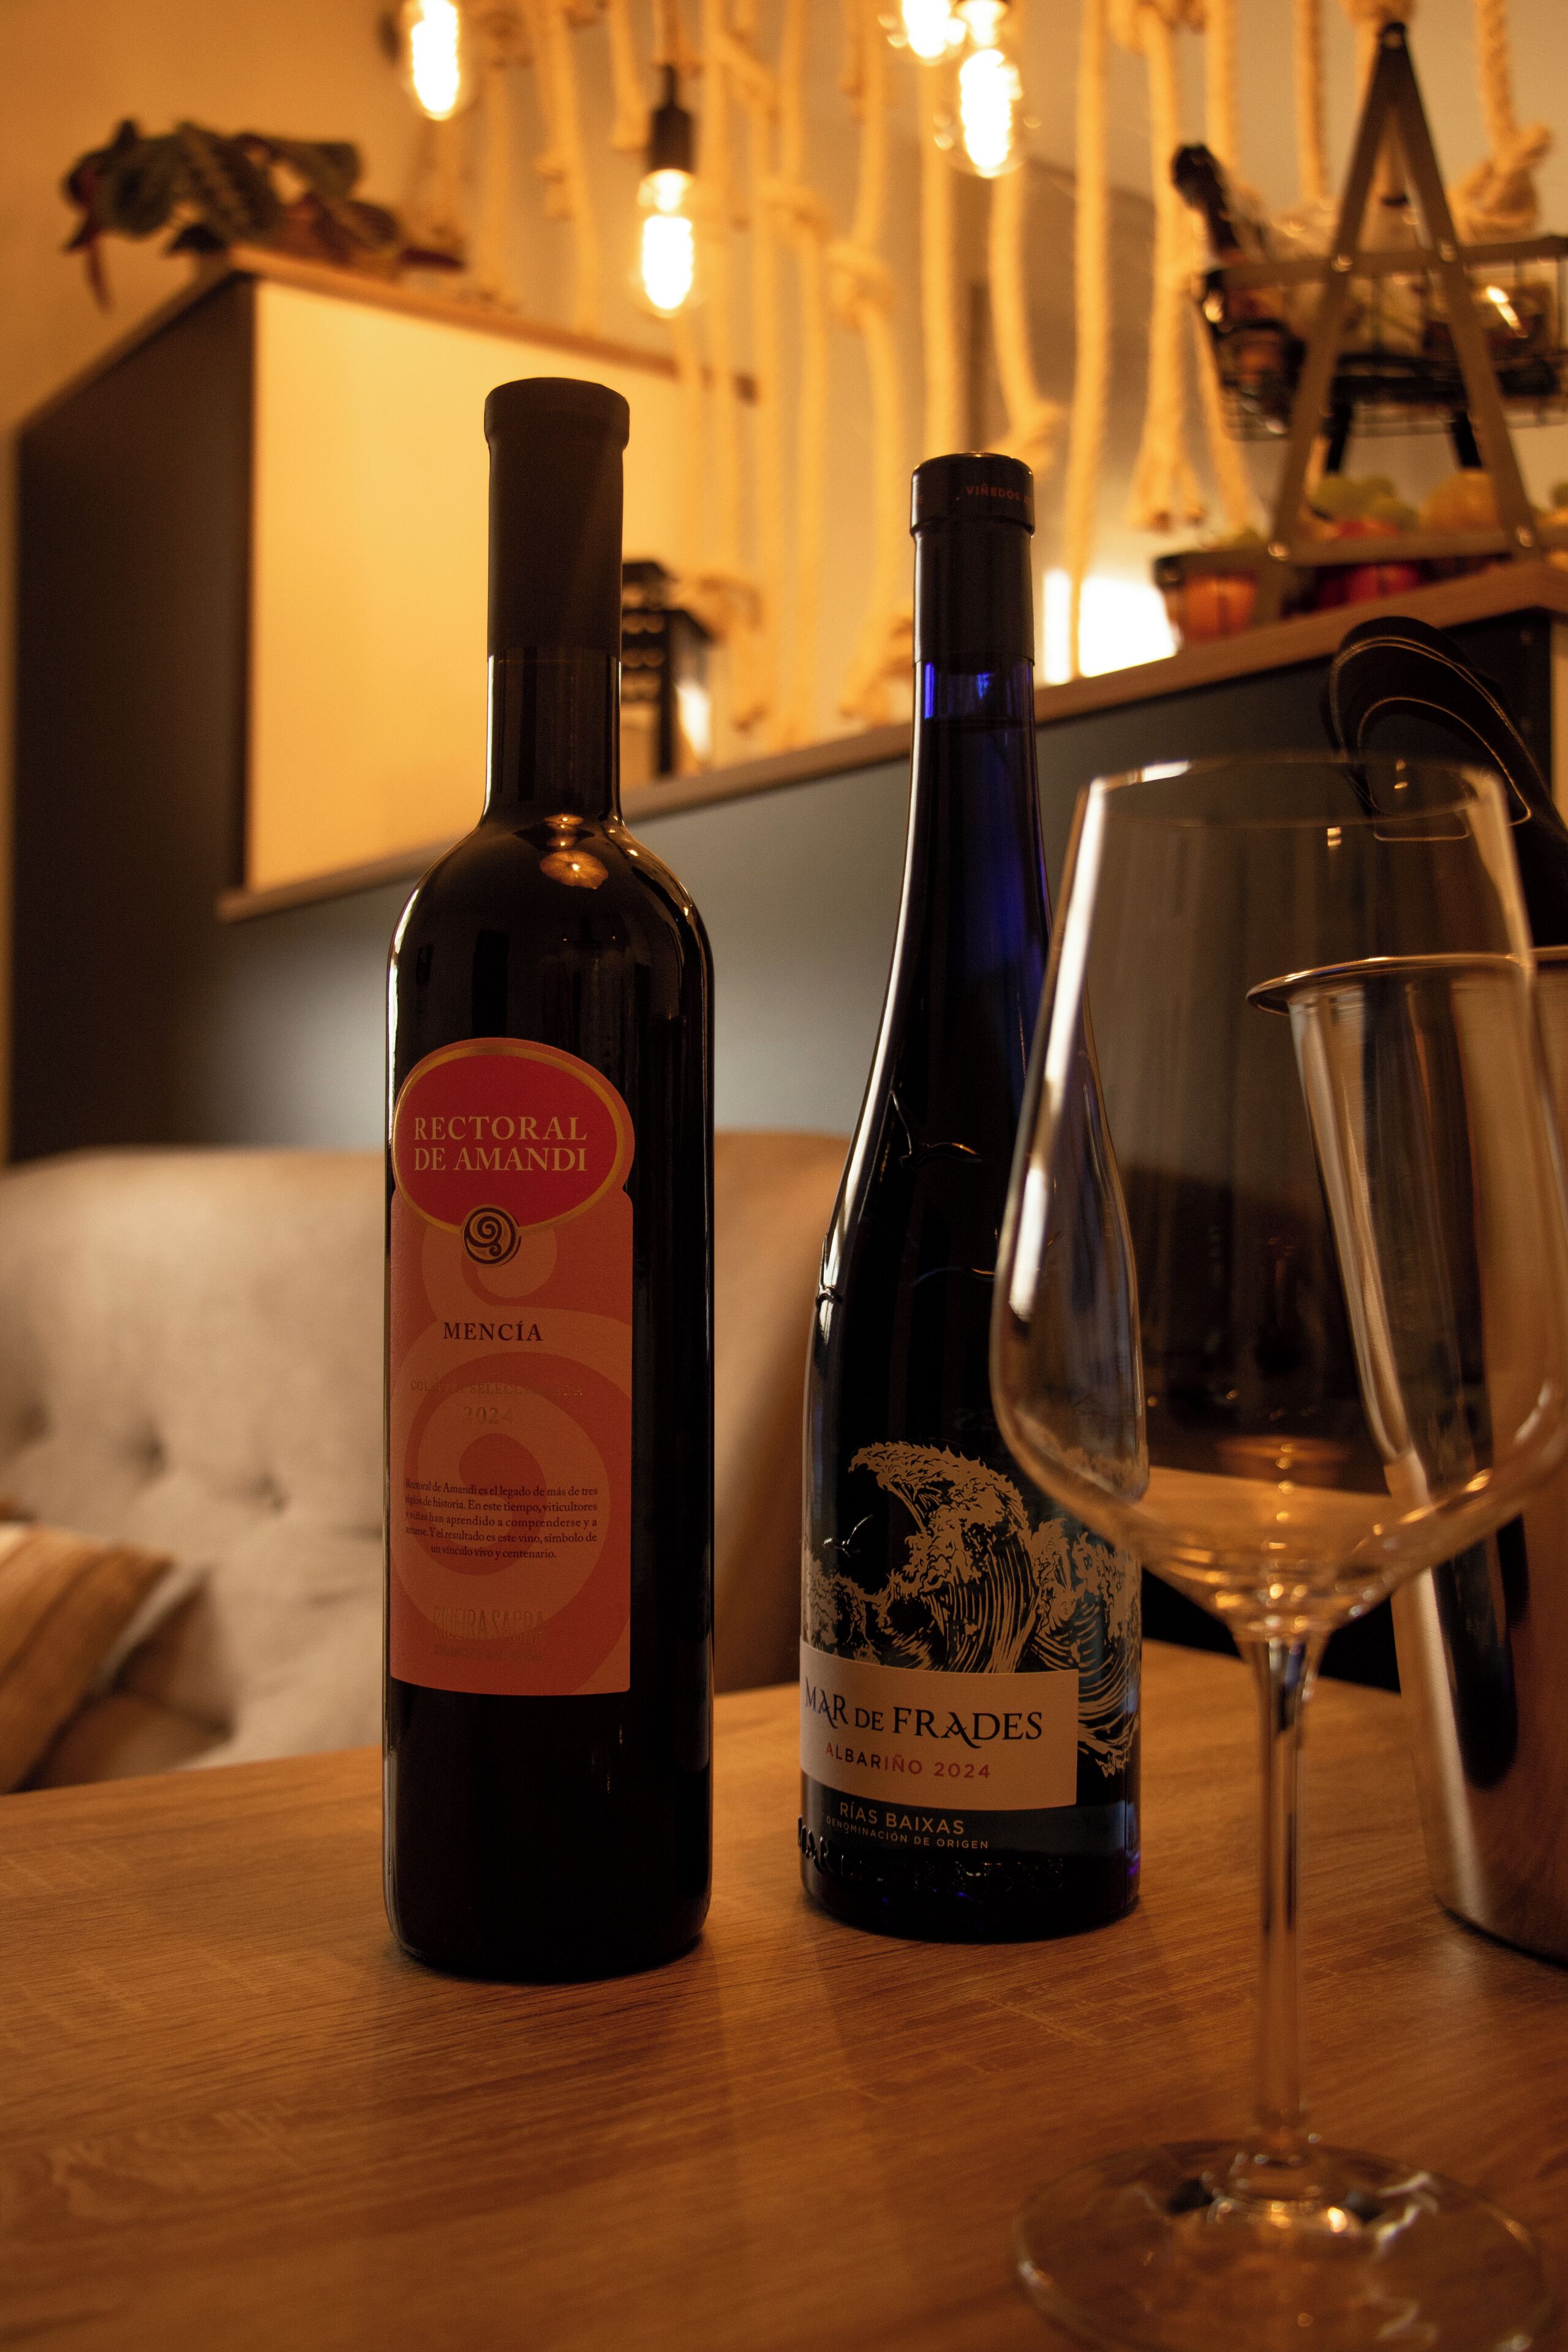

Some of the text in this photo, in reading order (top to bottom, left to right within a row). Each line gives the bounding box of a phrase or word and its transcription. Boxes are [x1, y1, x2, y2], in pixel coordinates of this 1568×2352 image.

[414, 1116, 587, 1140] RECTORAL
[414, 1147, 587, 1172] DE AMANDI
[443, 1320, 543, 1341] MENCÍA
[405, 1478, 431, 1490] Rectoral
[432, 1481, 441, 1492] de
[443, 1482, 477, 1494] Amandi
[489, 1485, 499, 1495] el
[500, 1485, 531, 1498] legado
[533, 1486, 545, 1496] de
[547, 1486, 566, 1496] más
[568, 1486, 579, 1496] de
[581, 1487, 598, 1496] tres
[405, 1494, 597, 1515] siglos de historia. En este tiempo, viticultores
[410, 1511, 428, 1521] viñas
[429, 1512, 444, 1523] han
[446, 1515, 495, 1527] aprendido
[505, 1517, 581, 1530] comprenderse
[583, 1520, 590, 1529] y
[405, 1526, 428, 1536] amarse.
[429, 1526, 436, 1537] Y
[437, 1528, 443, 1538] el
[445, 1530, 484, 1541] resultado
[498, 1534, 517, 1543] este
[519, 1533, 543, 1544] vino,
[544, 1532, 584, 1543] símbolo
[586, 1532, 597, 1542] de
[431, 1545, 557, 1560] un vínculo vivo y centenario.
[805, 1676, 1043, 1749] MAR DE FRADES
[826, 1741, 990, 1779] ALBARIÑO 2024
[840, 1801, 965, 1835] RÍAS BAIXAS
[826, 1815, 989, 1850] DENOMINACIÓN DE ORIGEN
